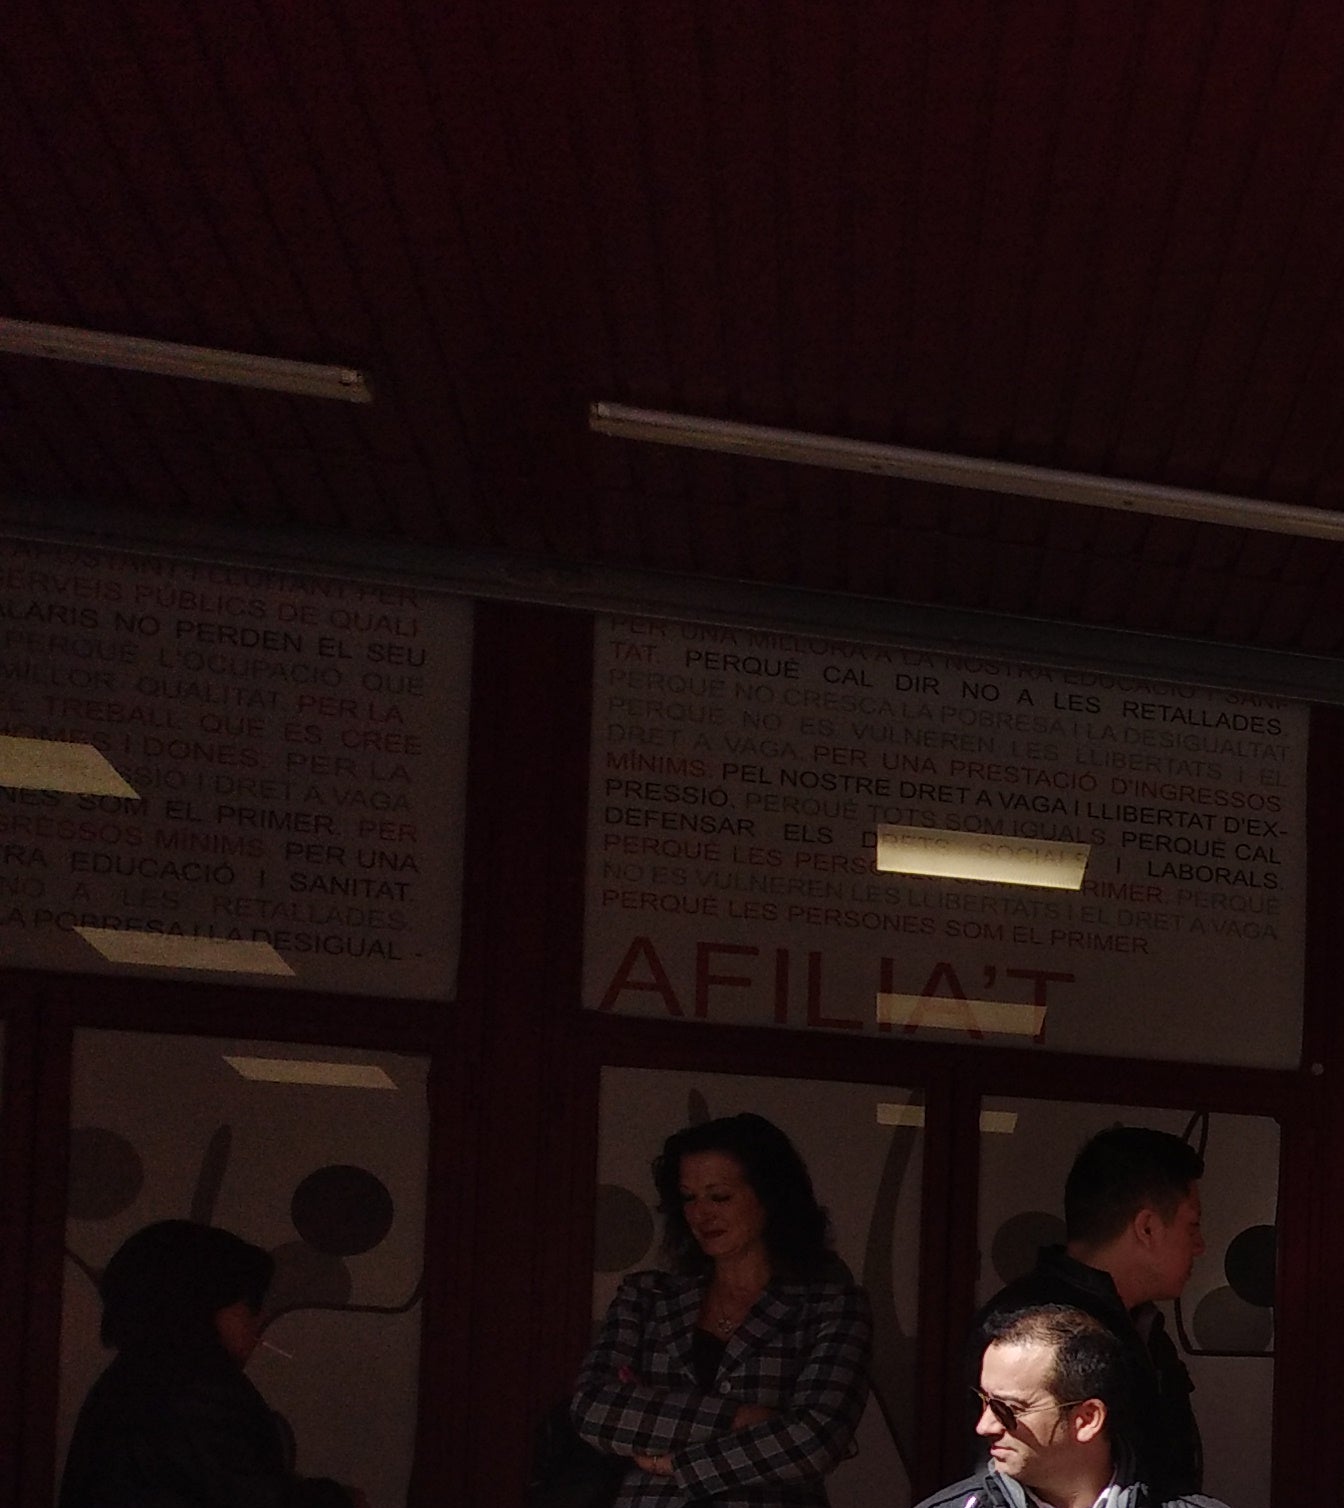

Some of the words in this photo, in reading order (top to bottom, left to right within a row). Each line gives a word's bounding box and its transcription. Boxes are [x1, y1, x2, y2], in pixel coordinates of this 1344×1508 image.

[0, 598, 97, 629] LARIS
[115, 612, 159, 636] NO
[176, 619, 301, 653] PERDEN
[318, 636, 352, 659] EL
[367, 642, 425, 667] SEU
[299, 694, 357, 718] PER
[369, 702, 403, 723] LA
[823, 665, 873, 688] CAL
[895, 674, 939, 696] DIR
[962, 681, 1000, 703] NO
[1016, 688, 1034, 707] A
[1054, 692, 1100, 715] LES
[814, 745, 866, 768] PER
[882, 752, 936, 776] UNA
[950, 760, 1097, 793] PRESTACIÓ
[166, 801, 202, 822] EL
[359, 819, 416, 843] PER
[722, 762, 771, 785] PEL
[781, 769, 890, 798] NOSTRE
[899, 781, 970, 806] DRET
[974, 789, 991, 808] A
[998, 792, 1067, 816] VAGA
[1087, 801, 1217, 832] LLIBERTAT
[1224, 816, 1287, 839] D'EX-
[604, 805, 755, 838] DEFENSAR
[784, 823, 833, 846] ELS
[868, 805, 936, 829] TOTS
[945, 812, 1003, 836] SOM
[1234, 842, 1280, 864] CAL
[71, 851, 235, 885] EDUCACIÓ
[285, 842, 345, 866] PER
[358, 849, 420, 873] UNA
[733, 846, 782, 868] LES
[728, 900, 777, 921] LES
[788, 905, 934, 935] PERSONES
[944, 919, 1002, 941] SOM
[1013, 925, 1042, 945] EL
[1051, 929, 1148, 954] PRIMER
[597, 934, 1075, 1045] AFILIA'T
